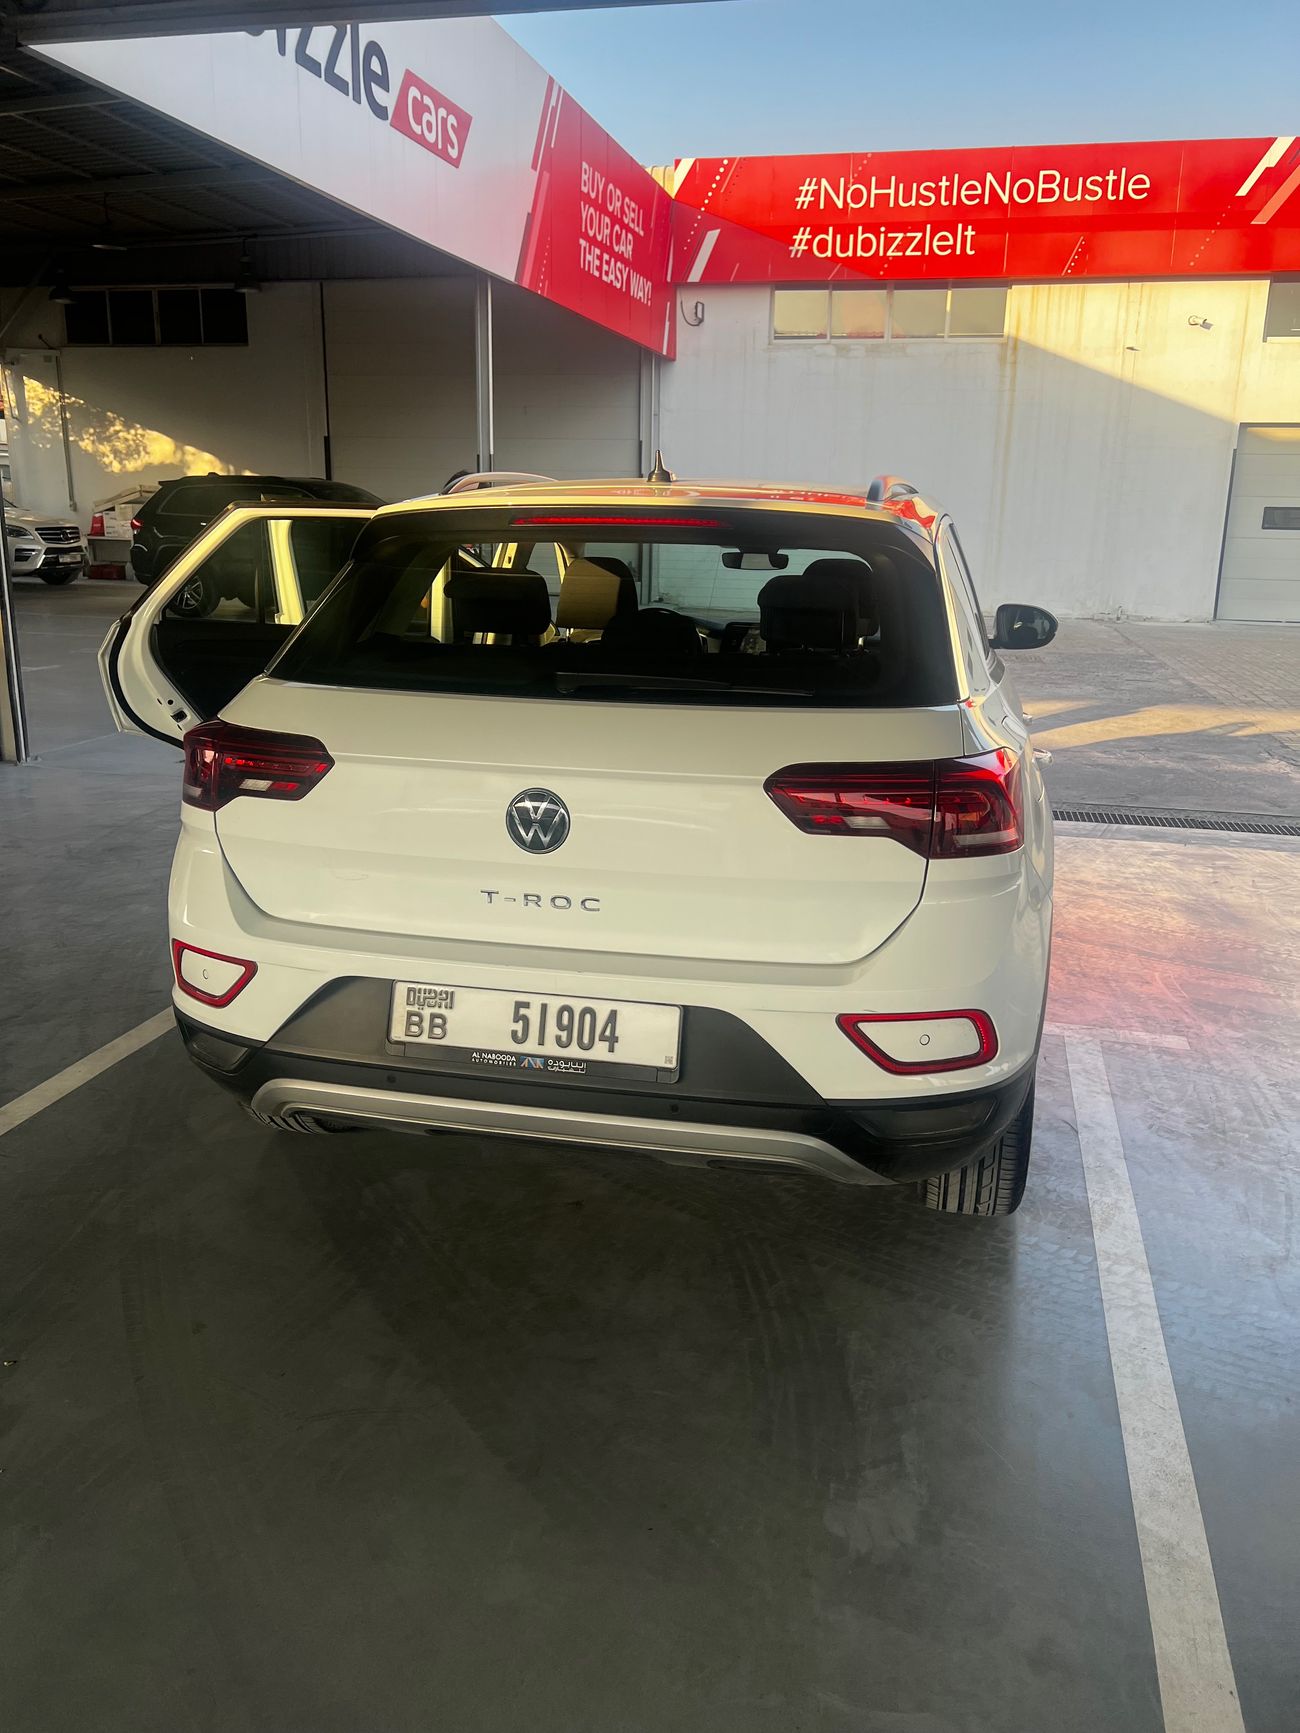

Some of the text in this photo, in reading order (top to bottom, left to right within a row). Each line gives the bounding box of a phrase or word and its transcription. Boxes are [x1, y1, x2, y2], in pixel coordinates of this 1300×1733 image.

[407, 85, 459, 160] cars
[580, 160, 645, 237] BUY OR SELL
[794, 167, 1151, 210] #NoHustleNoBustle
[580, 200, 634, 261] YOUR CAR
[788, 223, 977, 259] #dubizzleIt
[579, 238, 653, 307] THE EASY WAY!
[480, 889, 600, 912] T-ROC
[404, 1009, 448, 1040] BB
[510, 1000, 619, 1053] 51904
[482, 1052, 517, 1062] NABOODA
